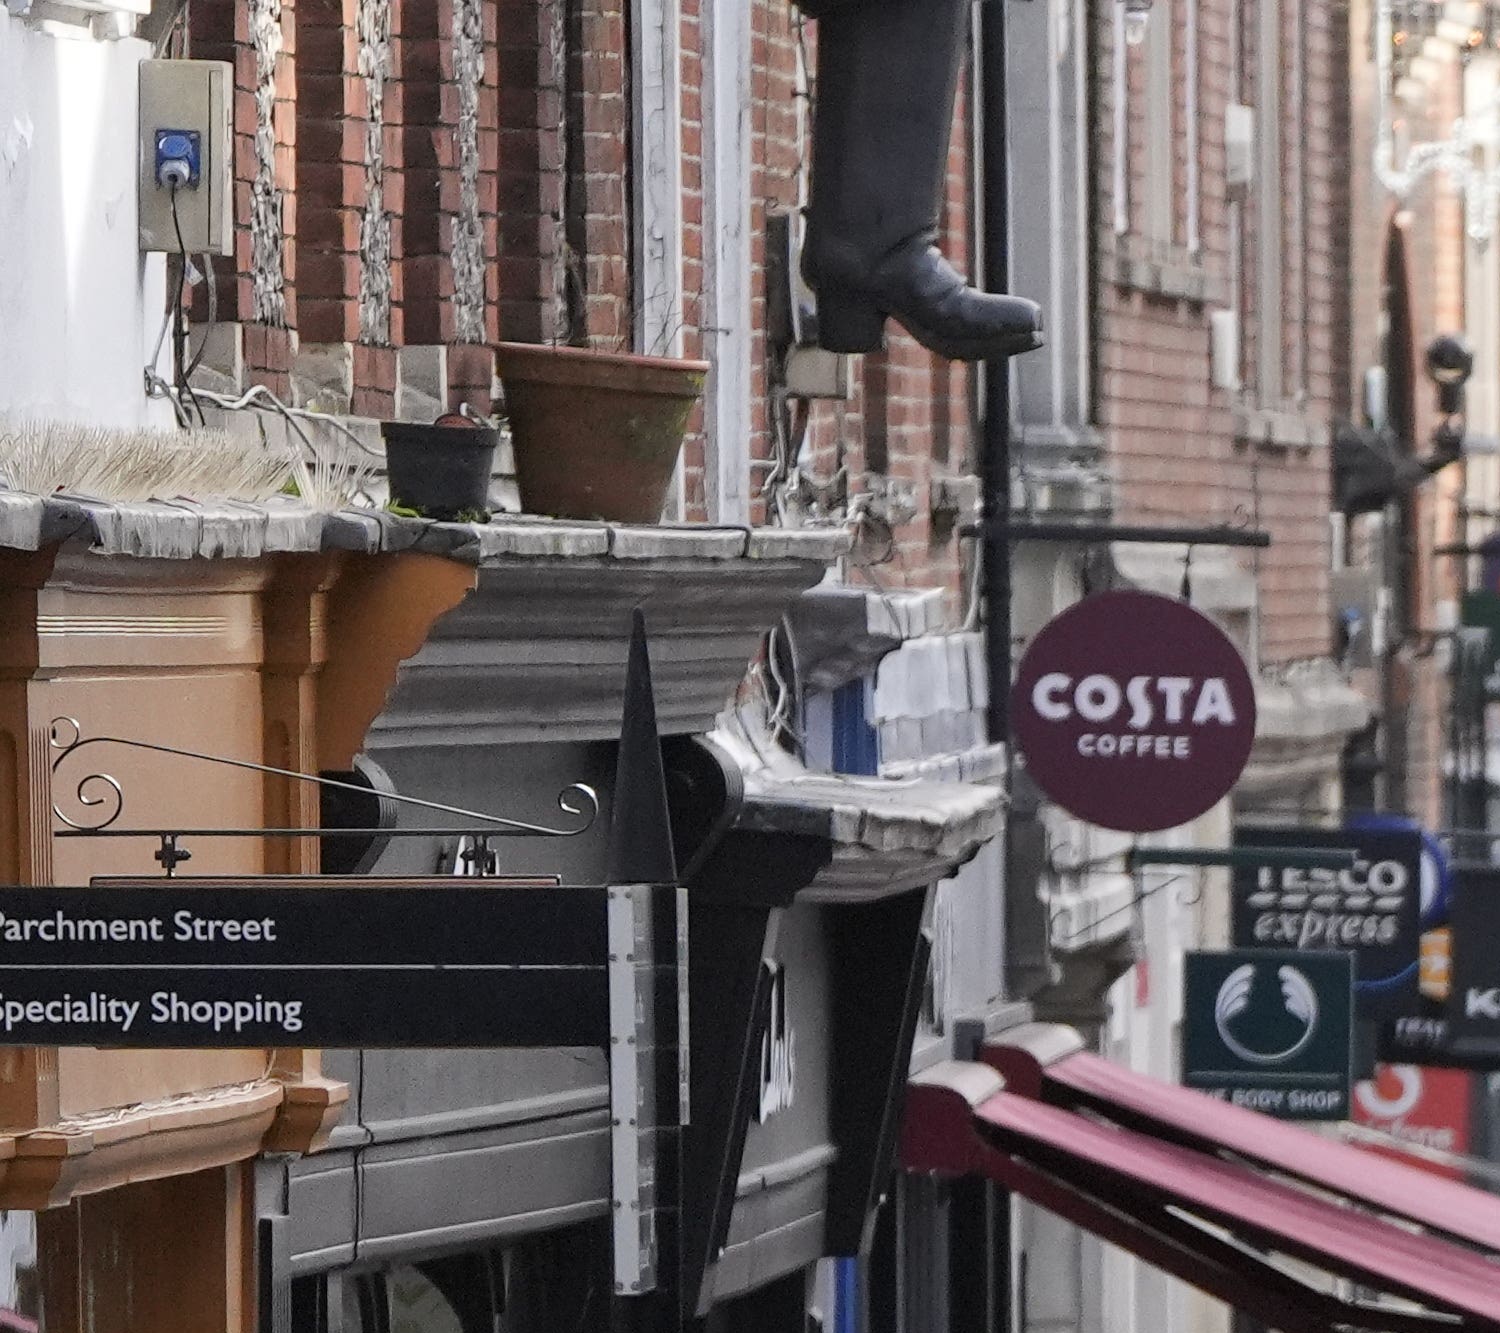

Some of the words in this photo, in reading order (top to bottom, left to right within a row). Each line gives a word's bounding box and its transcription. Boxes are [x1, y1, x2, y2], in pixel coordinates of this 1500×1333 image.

[1032, 672, 1236, 730] COSTA
[1077, 733, 1191, 760] COFFEE
[0, 910, 164, 942] archment
[173, 910, 277, 942] Street
[0, 991, 140, 1032] peciality
[151, 991, 303, 1032] Shopping
